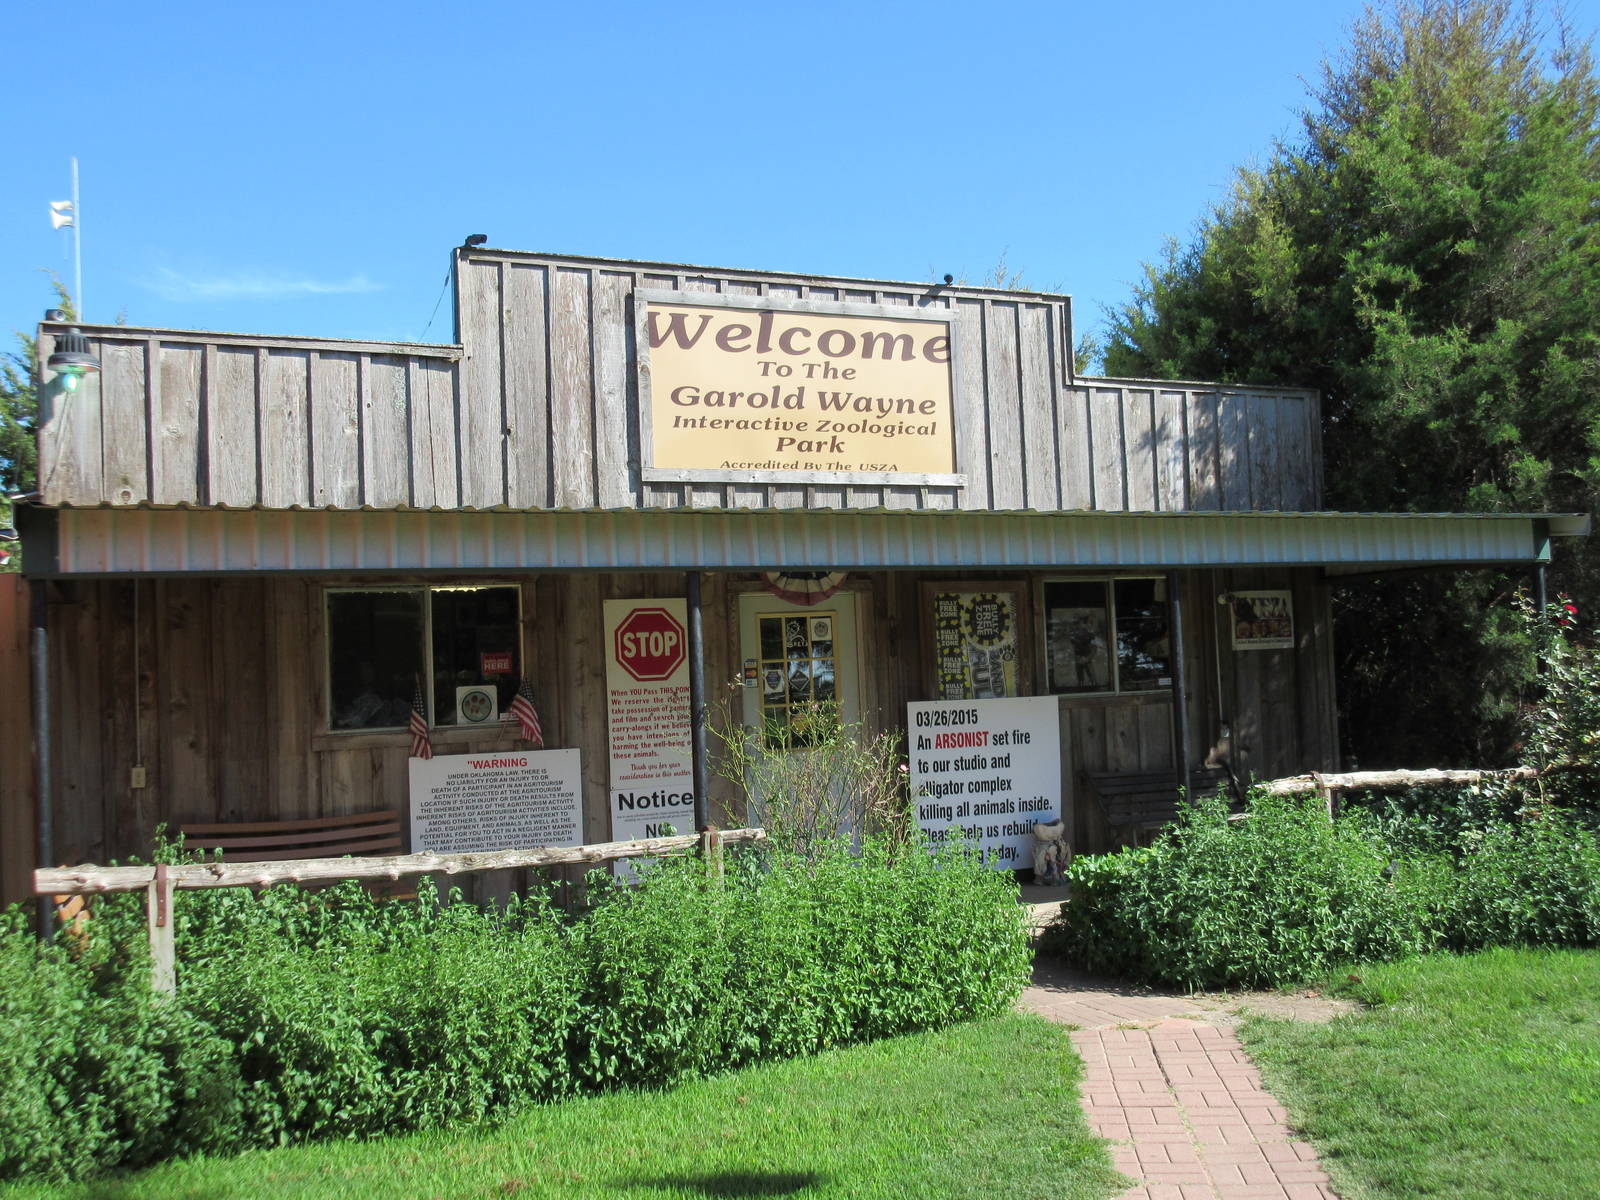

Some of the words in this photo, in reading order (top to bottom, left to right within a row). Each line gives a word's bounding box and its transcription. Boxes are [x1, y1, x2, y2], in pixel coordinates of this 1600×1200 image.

[648, 311, 950, 364] Welcome
[757, 361, 793, 378] To
[802, 361, 856, 380] The
[670, 385, 806, 410] Garold
[816, 391, 936, 420] Wayne
[673, 415, 808, 432] Interactive
[816, 420, 938, 438] Zoological
[776, 436, 846, 454] Park
[720, 460, 799, 470] Accredited
[804, 462, 823, 471] By
[827, 462, 852, 471] The
[859, 463, 898, 472] USZA
[976, 605, 986, 636] ZONE
[983, 604, 992, 636] FREE
[991, 604, 1000, 634] BULLY
[624, 632, 677, 658] STOP
[484, 662, 509, 671] HERE
[612, 724, 652, 733] carry-alongs
[916, 709, 978, 728] 03/26/2015
[612, 742, 638, 751] harming
[653, 739, 685, 748] well-being
[918, 735, 932, 750] An
[935, 731, 989, 749] ARSONIST
[992, 731, 1008, 746] set
[1013, 730, 1031, 744] fire
[918, 759, 928, 774] to
[933, 759, 951, 772] our
[954, 755, 987, 771] studio
[991, 753, 1010, 768] and
[919, 780, 964, 799] alligator
[968, 777, 1012, 795] complex
[618, 790, 694, 811] Notice
[920, 804, 952, 821] killing
[957, 801, 969, 817] all
[974, 798, 1015, 816] animals
[1018, 796, 1052, 812] inside.
[523, 836, 566, 844] PARTICIPATING
[987, 825, 999, 838] us
